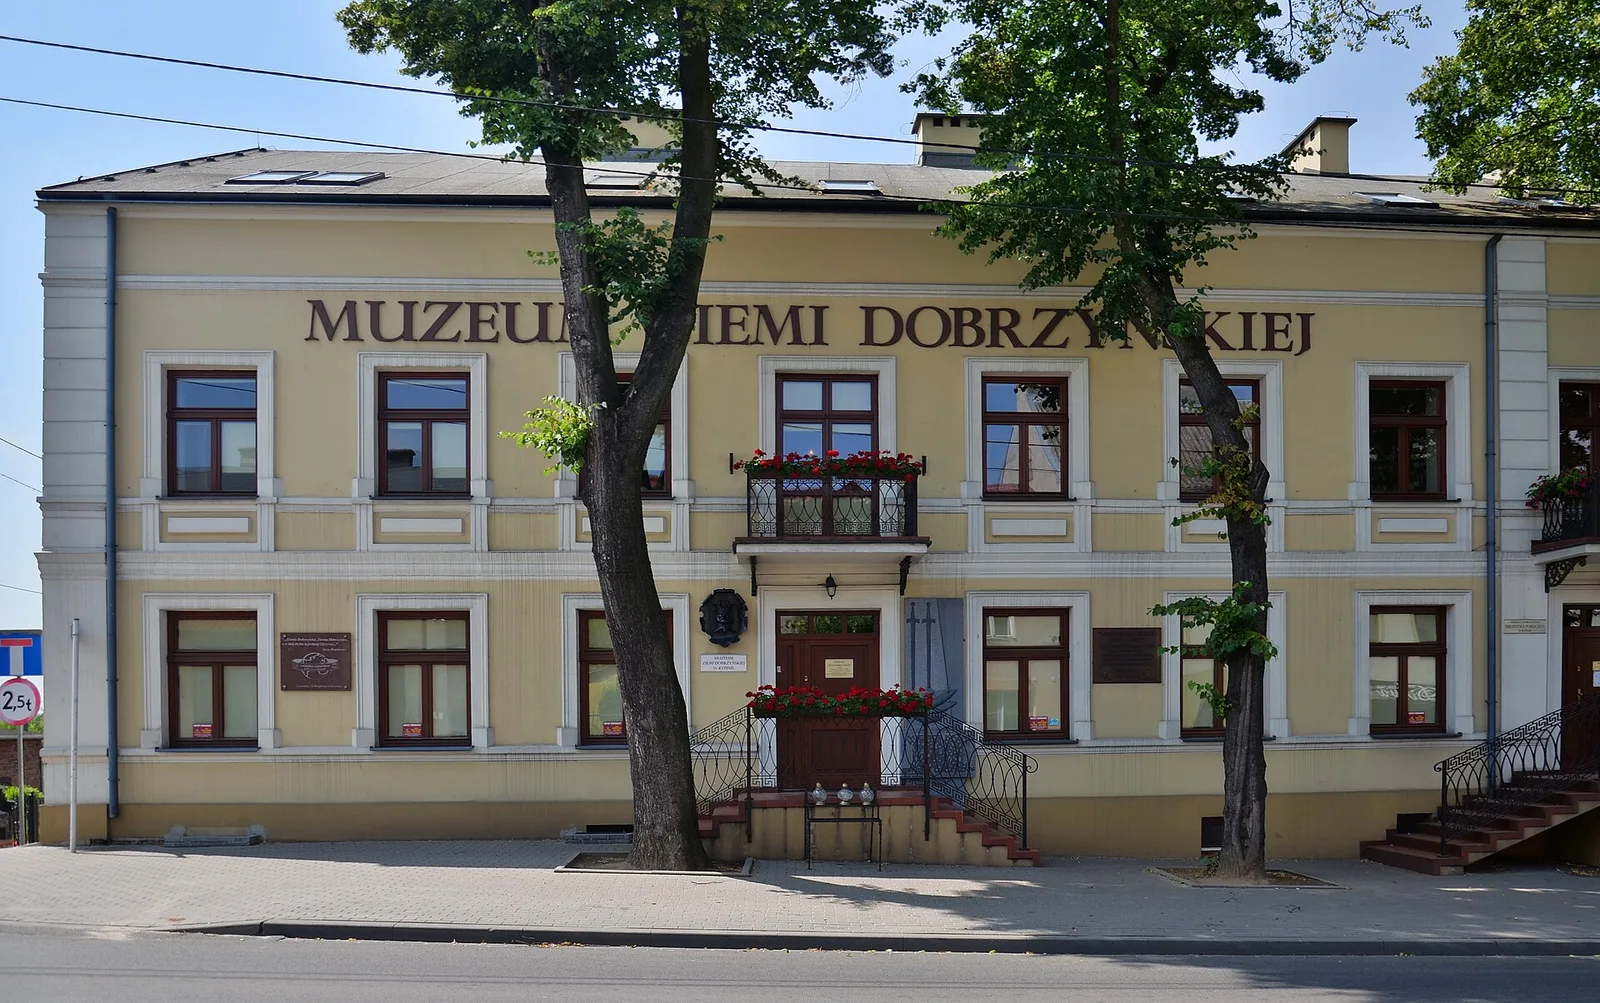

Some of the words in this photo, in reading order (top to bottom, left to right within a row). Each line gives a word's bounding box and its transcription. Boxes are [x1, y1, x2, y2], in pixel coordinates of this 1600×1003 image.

[693, 304, 829, 347] IEMI
[858, 305, 1317, 357] DOBRZYKIEJ
[2, 690, 32, 712] 2,5t
